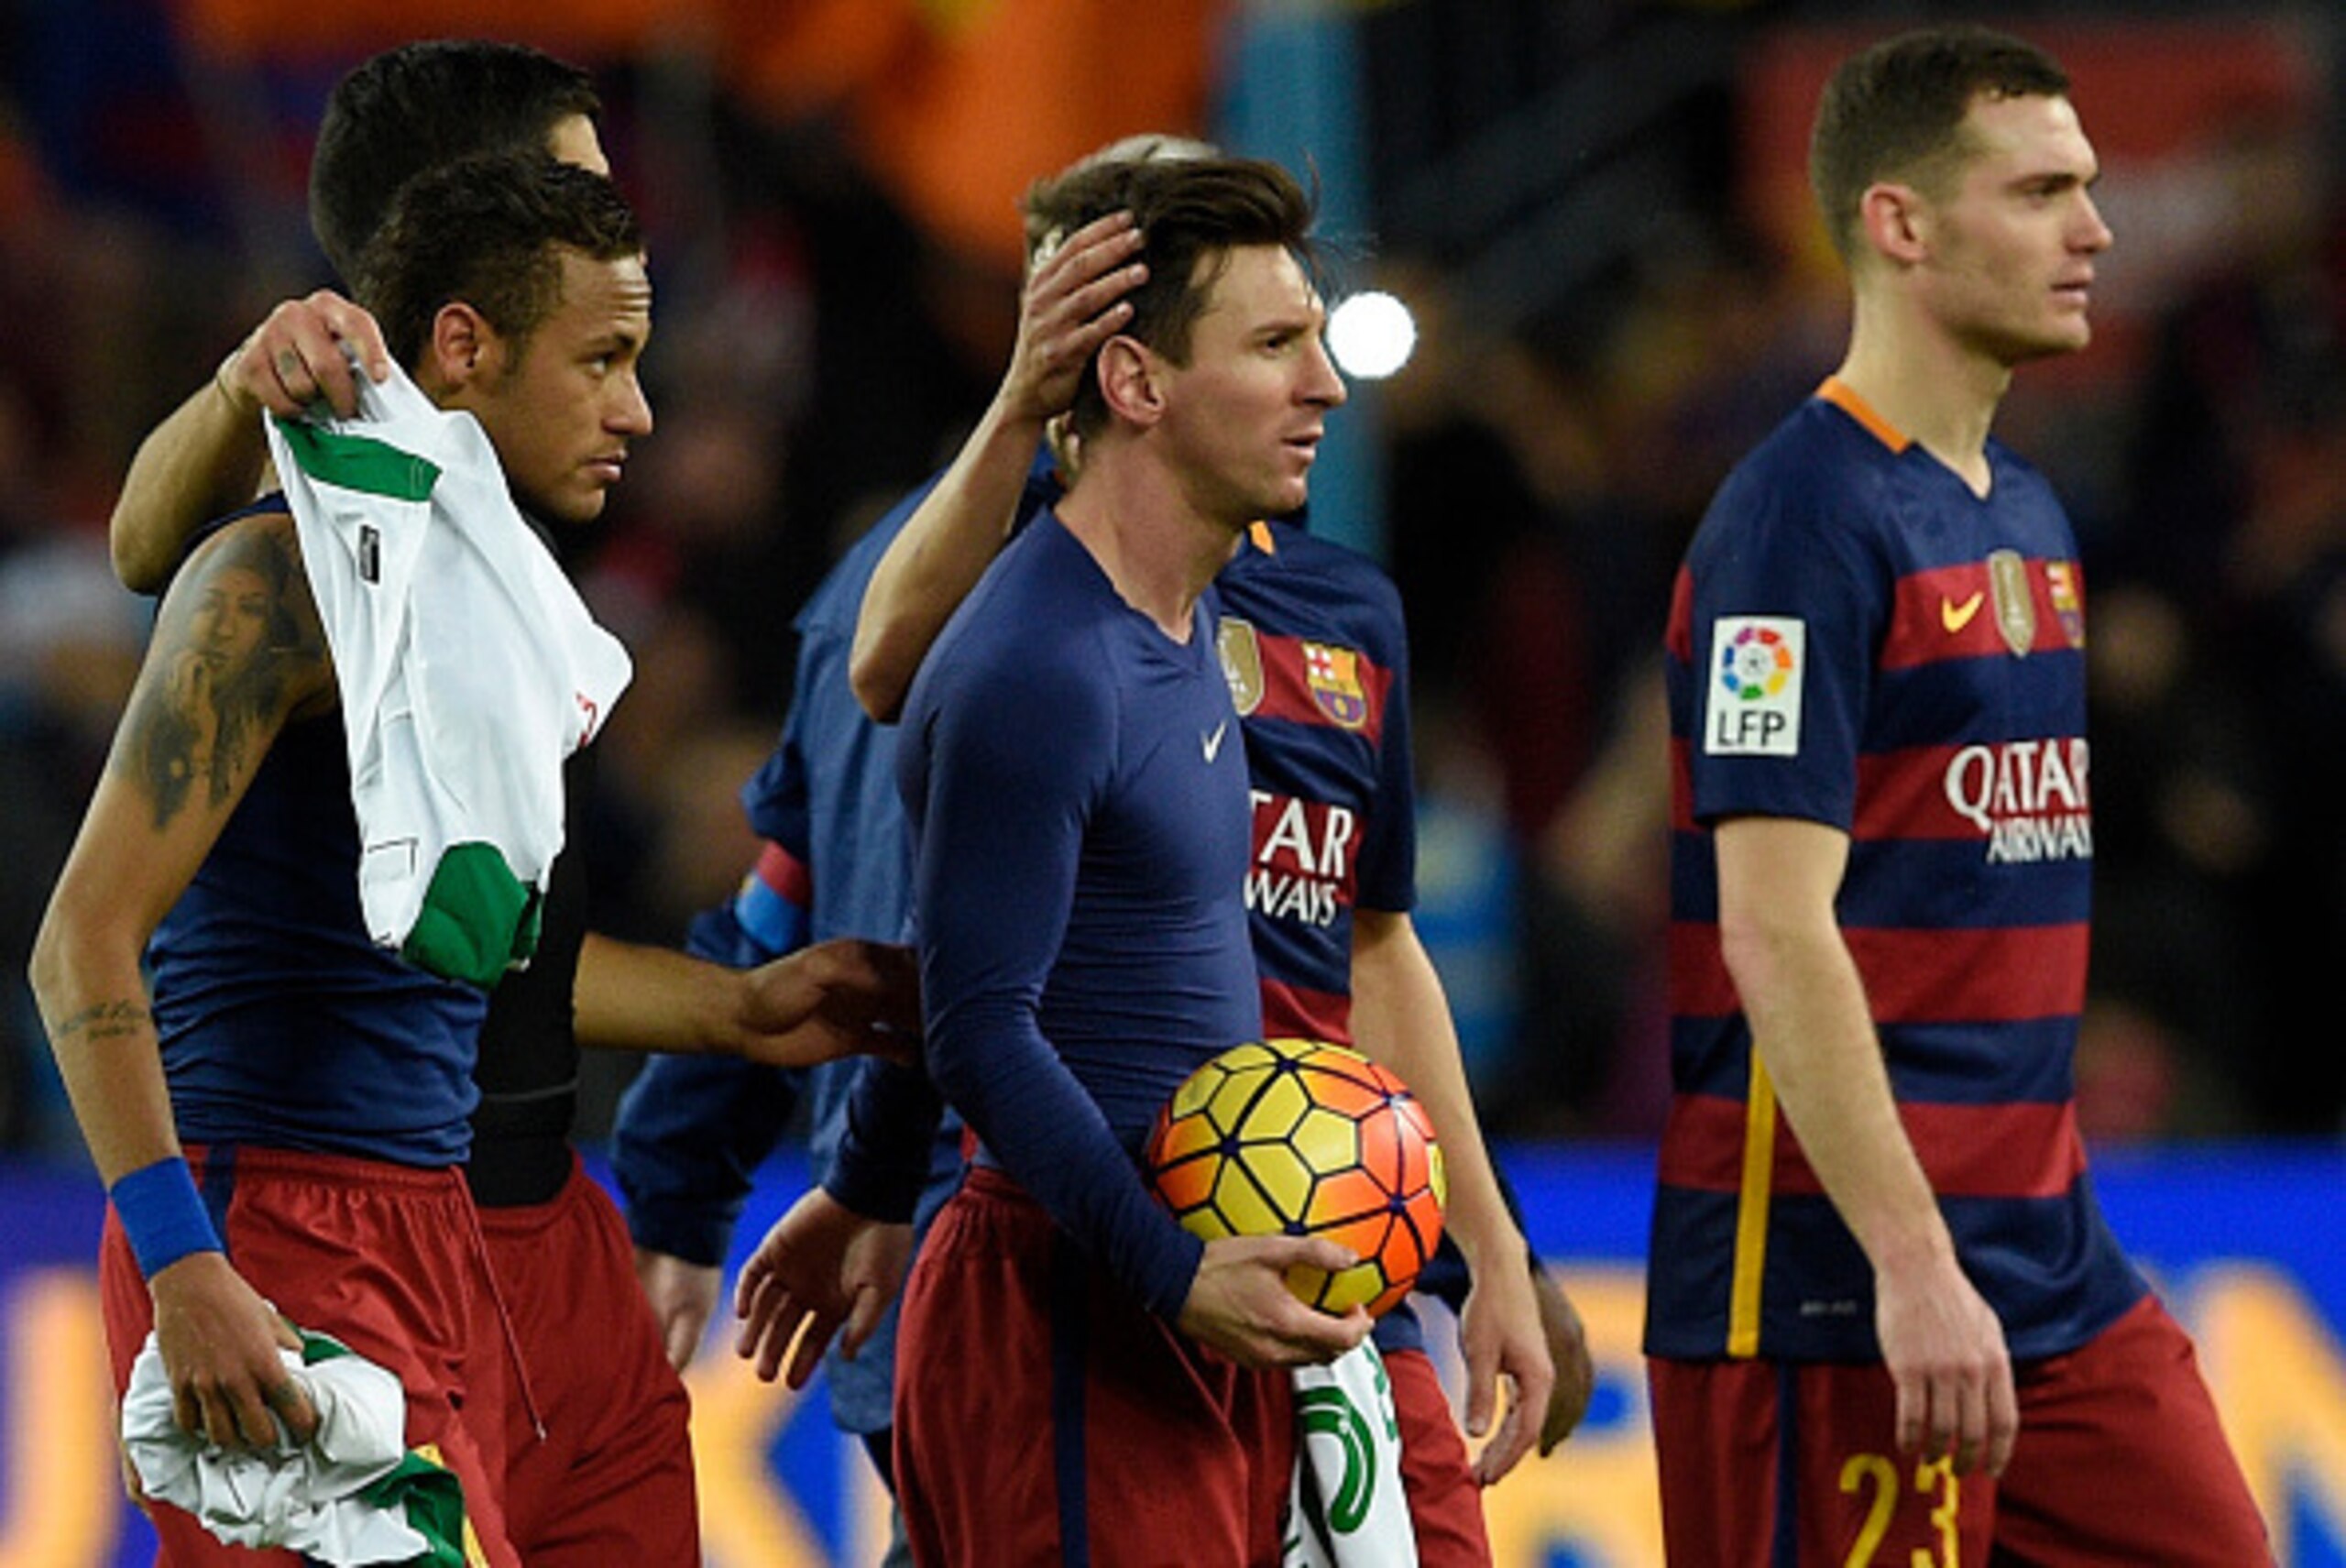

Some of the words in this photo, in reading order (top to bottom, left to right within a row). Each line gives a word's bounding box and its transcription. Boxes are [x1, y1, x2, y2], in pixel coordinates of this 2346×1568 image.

[1717, 709, 1786, 746] LFP
[1244, 869, 1339, 928] WAYS
[1839, 1453, 1959, 1568] 23
